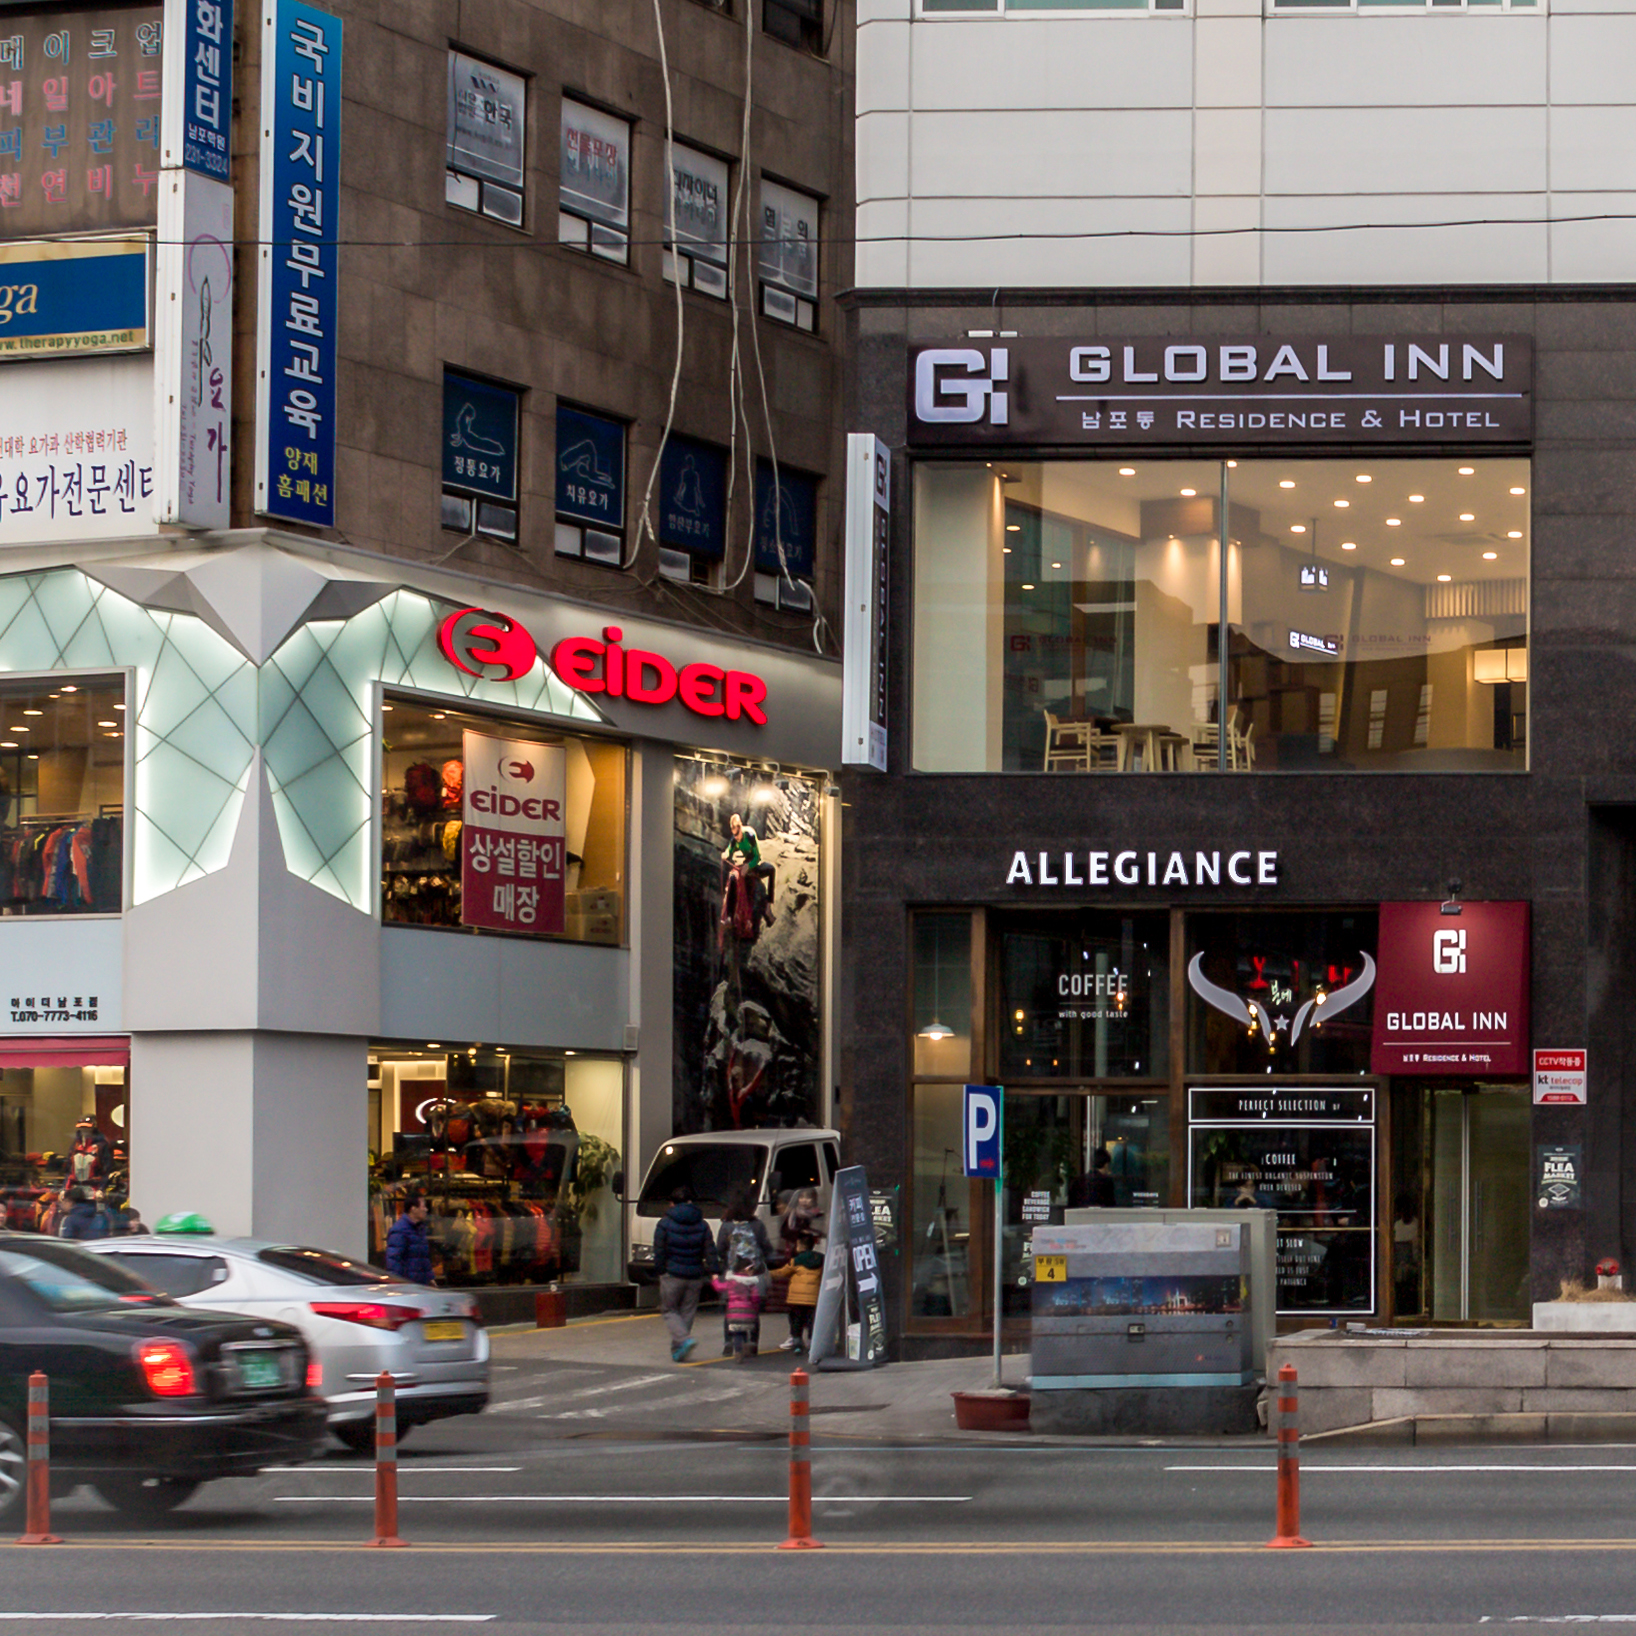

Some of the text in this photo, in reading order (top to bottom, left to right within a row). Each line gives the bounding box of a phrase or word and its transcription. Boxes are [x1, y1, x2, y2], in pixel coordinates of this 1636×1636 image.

[284, 18, 329, 440] 국비지원무료교육
[1069, 343, 1504, 383] GLOBAL INN
[1082, 410, 1155, 430] 남포동
[1360, 409, 1383, 429] &
[284, 443, 318, 477] 양재
[469, 833, 560, 880] 상설할인
[1005, 850, 1278, 886] ALLEGIANCE
[492, 883, 540, 924] 매장
[1058, 974, 1129, 996] COFFEE
[1058, 1009, 1129, 1020] with good taste
[1387, 1011, 1508, 1030] GLOBAL INN
[1537, 1074, 1549, 1085] kt
[1238, 1099, 1275, 1112] PERFECT
[1278, 1099, 1327, 1112] SELECTION
[968, 1092, 997, 1170] P
[1265, 1153, 1297, 1166] COFFEE
[1544, 1161, 1575, 1173] FLEA
[852, 1242, 878, 1273] OPEN
[1047, 1267, 1056, 1280] 4
